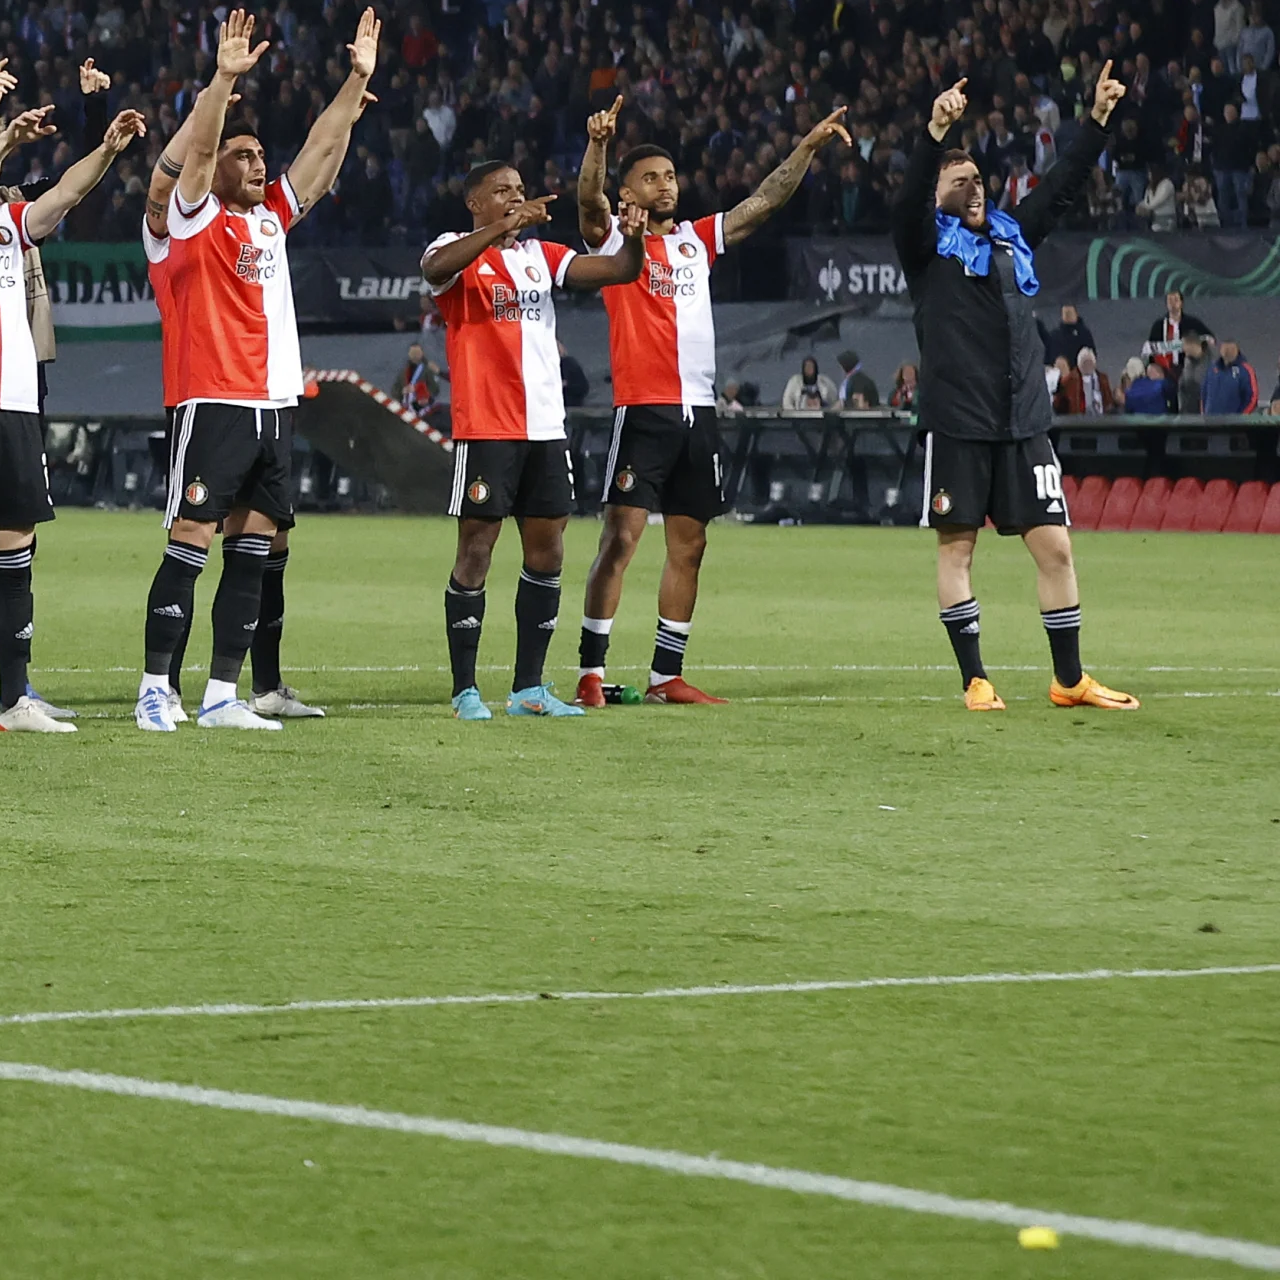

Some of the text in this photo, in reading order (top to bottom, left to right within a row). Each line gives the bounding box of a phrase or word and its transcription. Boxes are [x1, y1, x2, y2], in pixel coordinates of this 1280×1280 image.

[650, 262, 694, 280] Euro
[493, 285, 540, 304] Euro
[649, 280, 696, 297] Parcs
[494, 304, 541, 321] Parcs
[1032, 464, 1062, 500] 10
